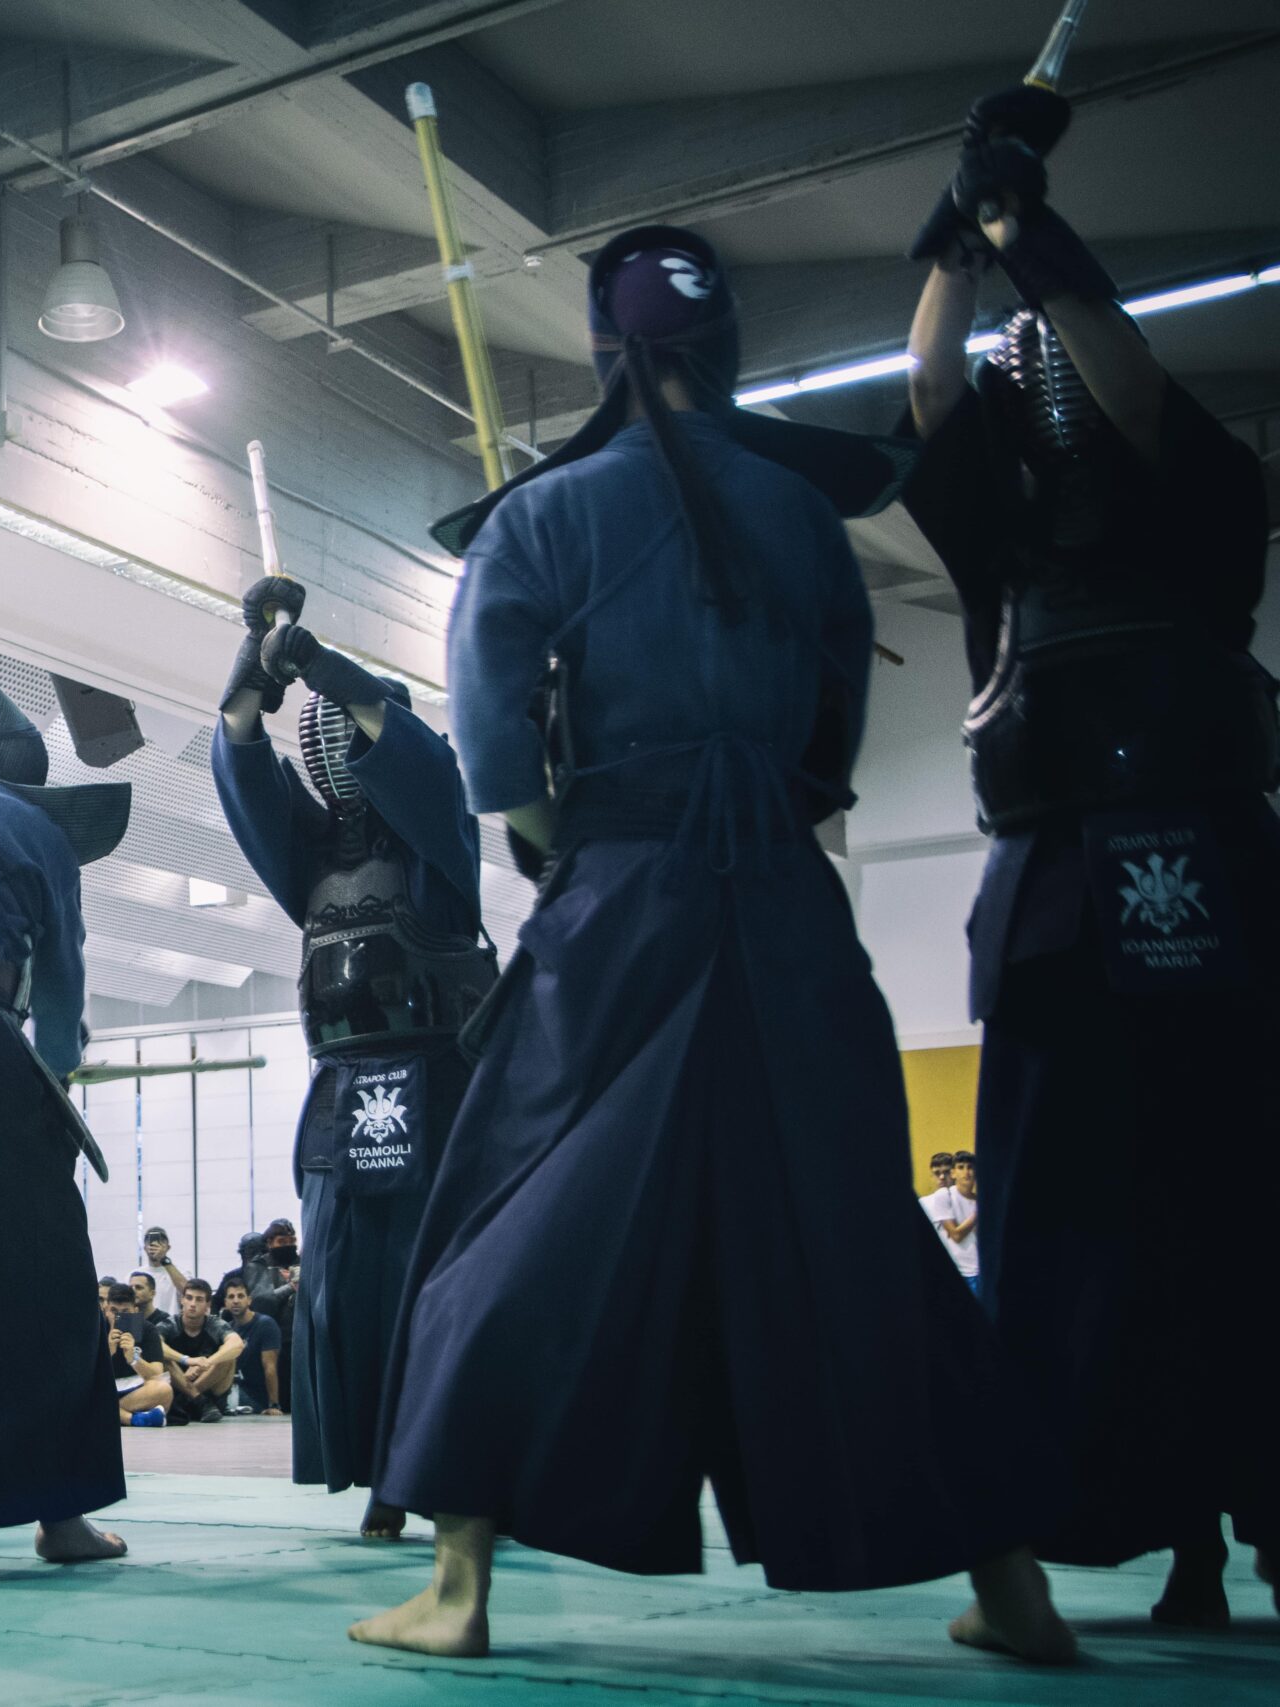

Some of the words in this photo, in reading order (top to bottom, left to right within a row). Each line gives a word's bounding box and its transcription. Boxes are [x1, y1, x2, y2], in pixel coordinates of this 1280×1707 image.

[1121, 934, 1220, 955] IOANNIDOU
[1144, 951, 1203, 970] MARIA
[387, 1069, 408, 1081] CLUB
[349, 1143, 411, 1158] STAMOULI
[356, 1157, 405, 1170] IOANNA
